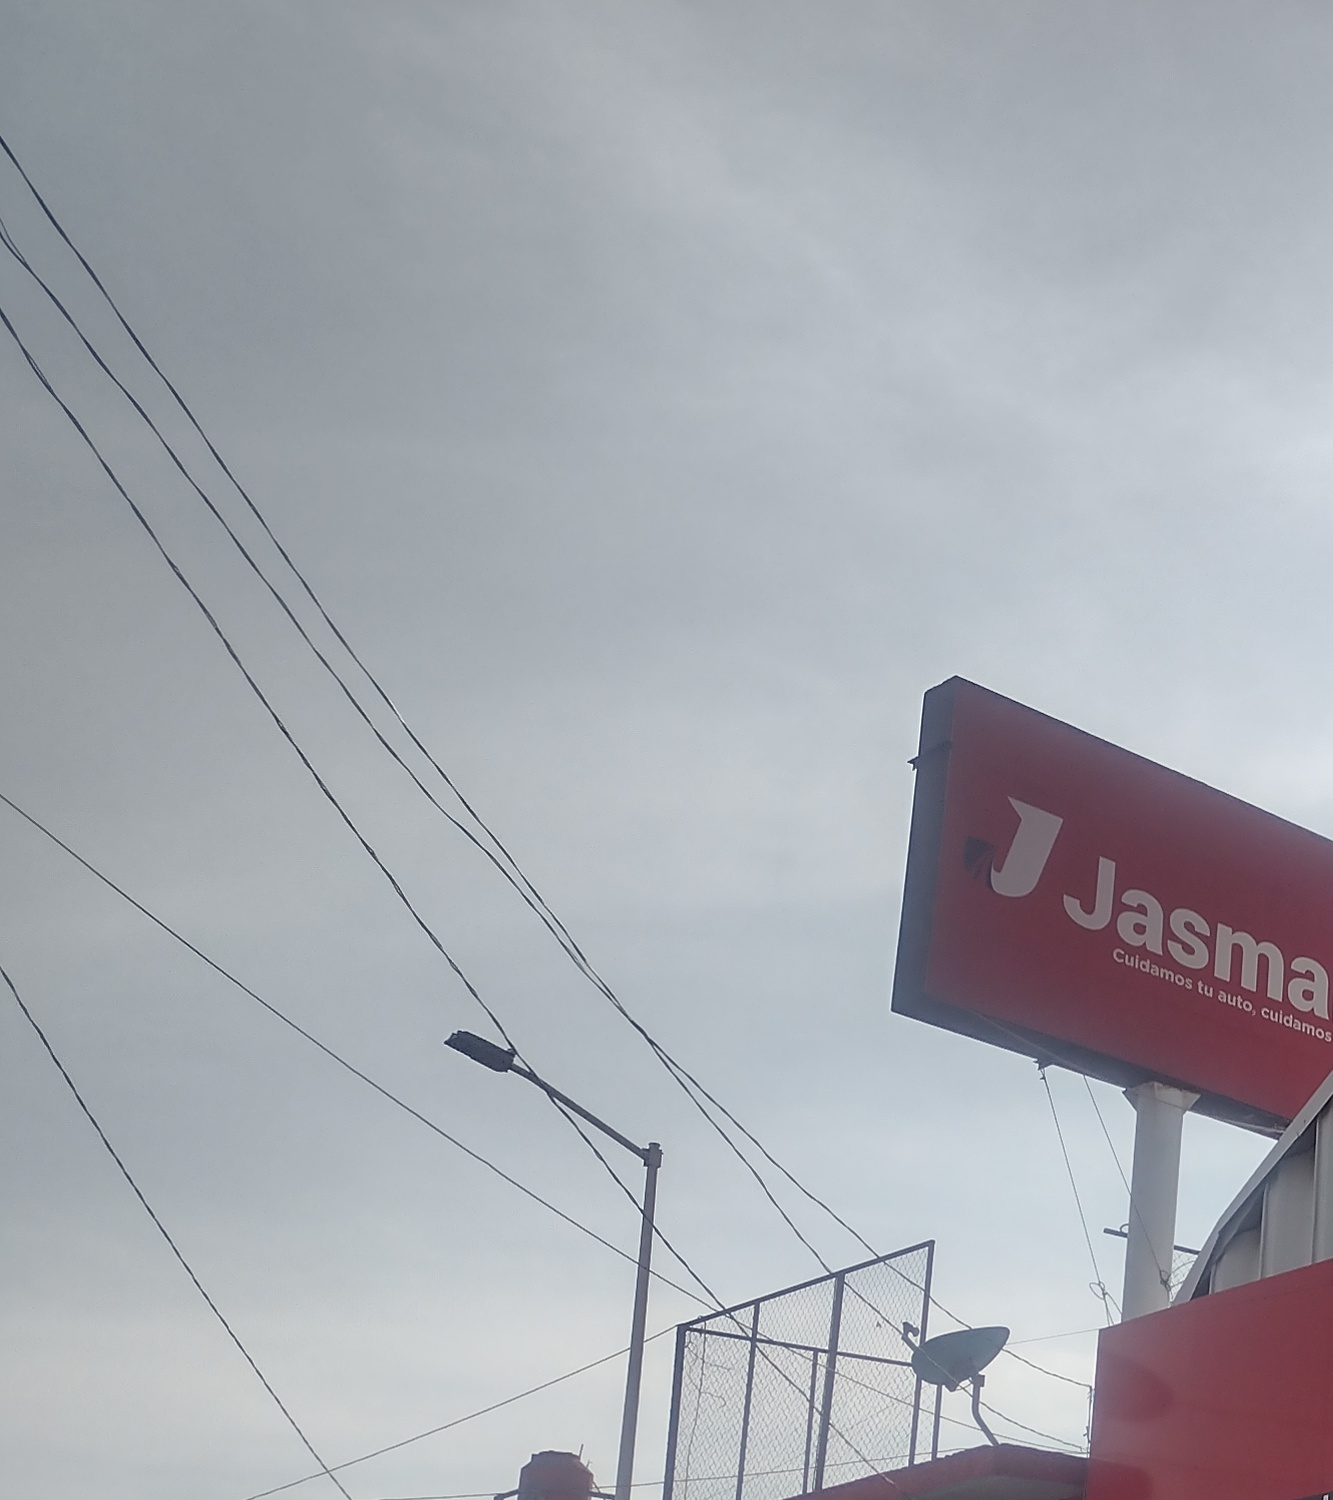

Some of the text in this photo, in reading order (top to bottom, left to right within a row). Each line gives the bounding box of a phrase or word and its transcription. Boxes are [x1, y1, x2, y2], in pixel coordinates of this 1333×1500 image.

[1112, 948, 1193, 990] Cuidamos
[1197, 980, 1213, 998] tu
[1218, 990, 1256, 1017] auto,
[1261, 1006, 1332, 1043] cuidamos
